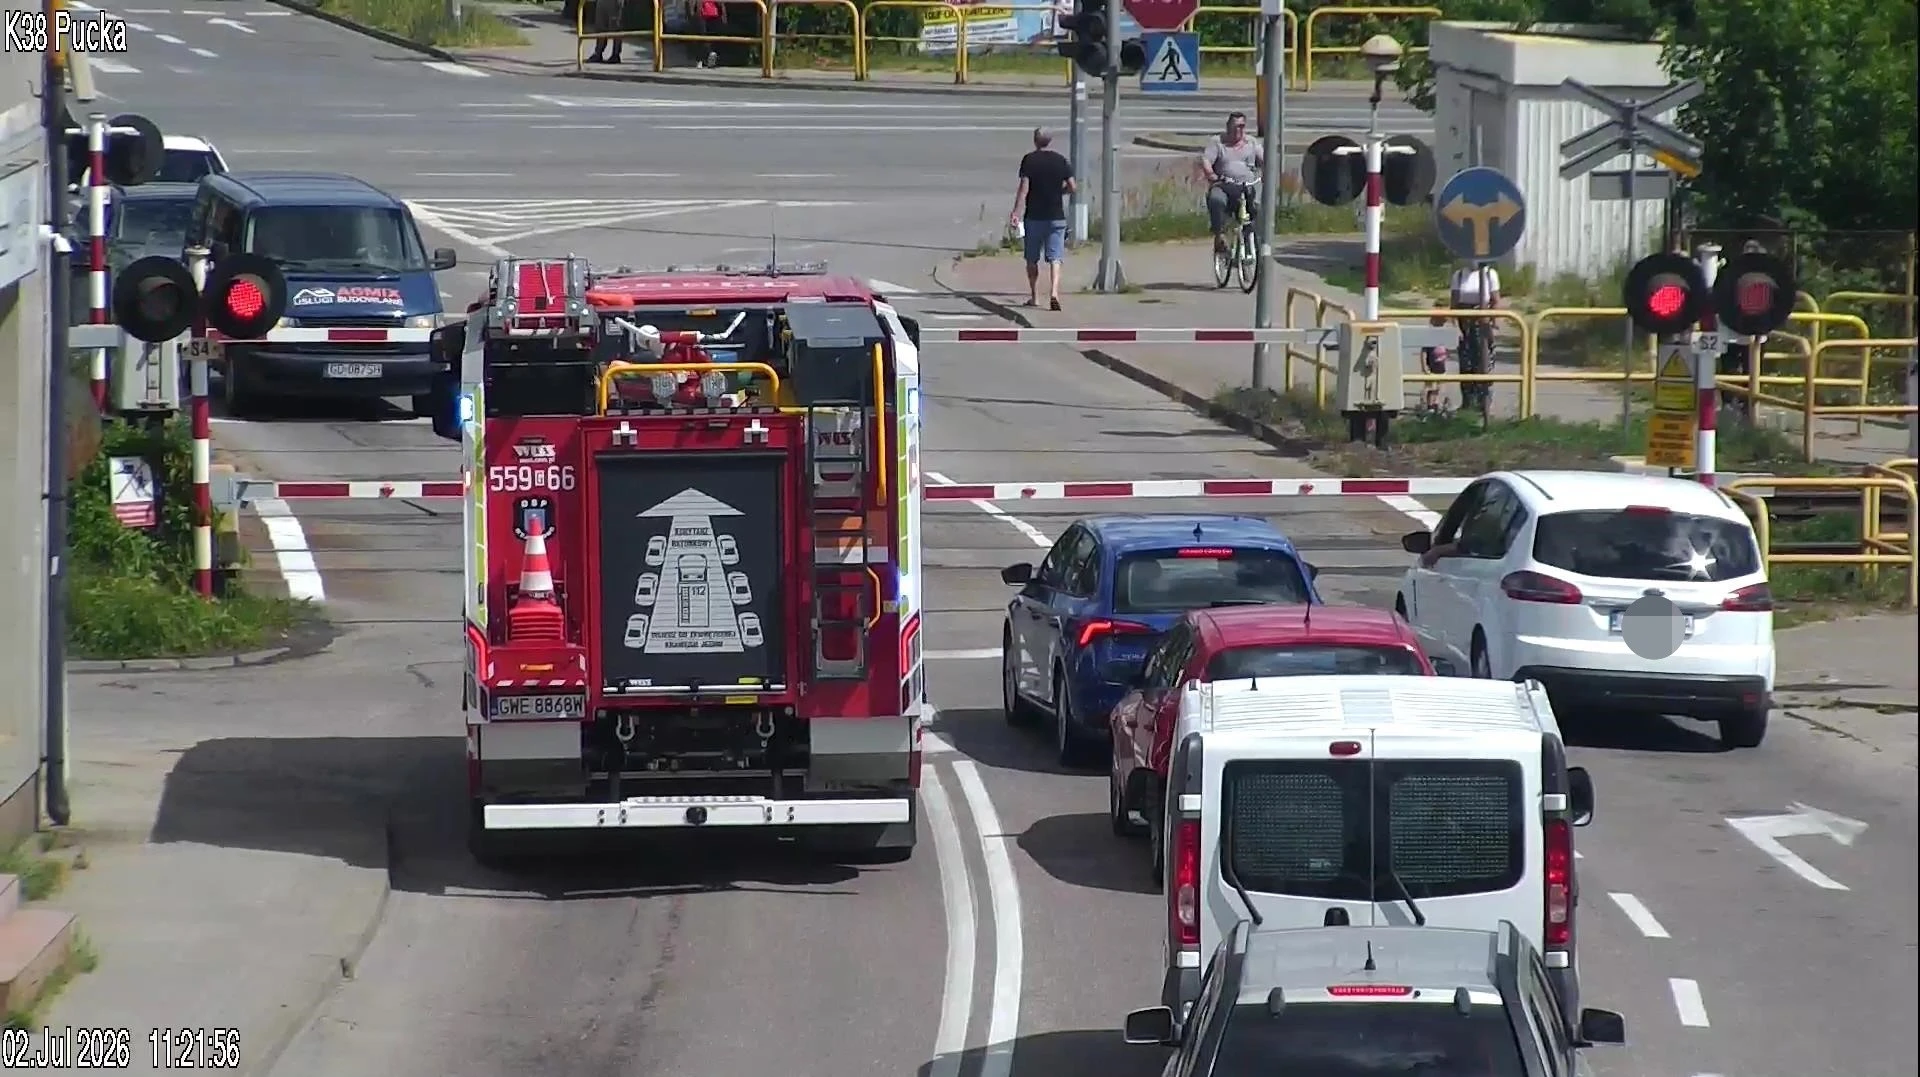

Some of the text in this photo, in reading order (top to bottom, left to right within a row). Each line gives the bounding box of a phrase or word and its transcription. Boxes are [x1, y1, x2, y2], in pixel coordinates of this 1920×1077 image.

[191, 341, 209, 356] S4
[1699, 335, 1718, 350] S2
[691, 585, 706, 596] 112
[499, 697, 583, 714] GWE 8868W
